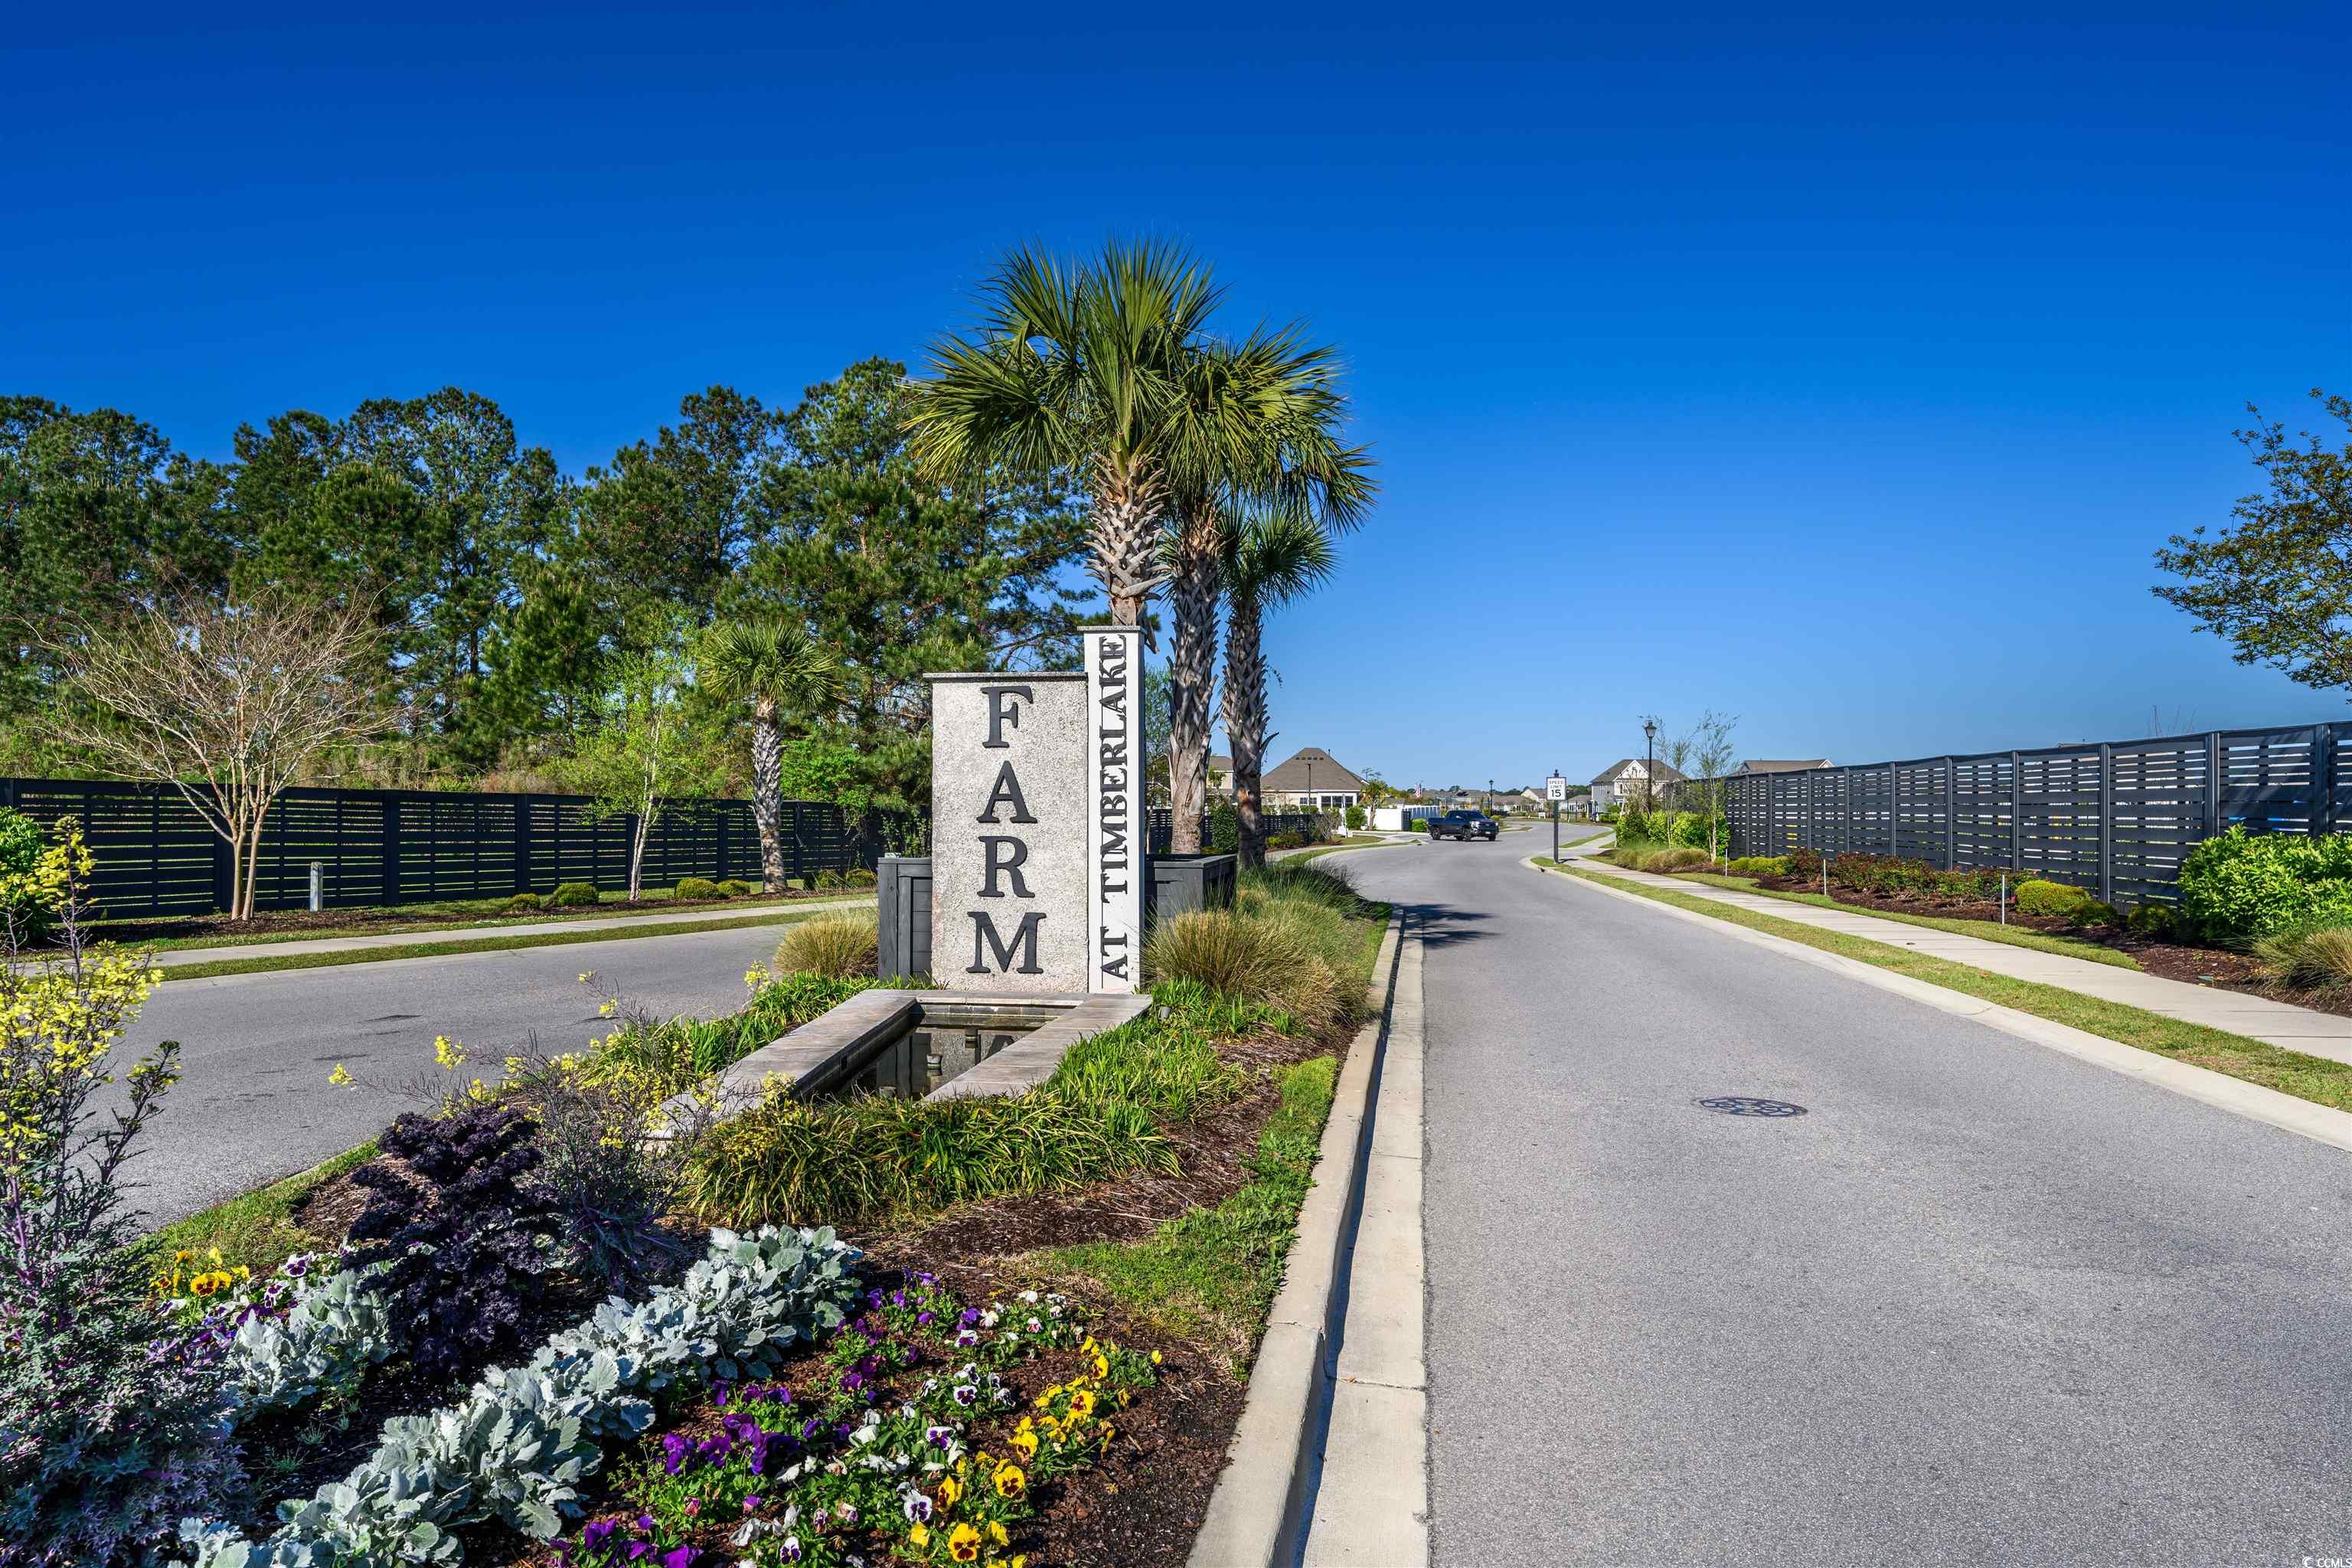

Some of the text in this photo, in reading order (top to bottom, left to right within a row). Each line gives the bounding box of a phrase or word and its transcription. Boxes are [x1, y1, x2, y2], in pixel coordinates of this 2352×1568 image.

[965, 686, 1047, 974] FARM
[1099, 635, 1128, 982] AT TIMBERLAKE
